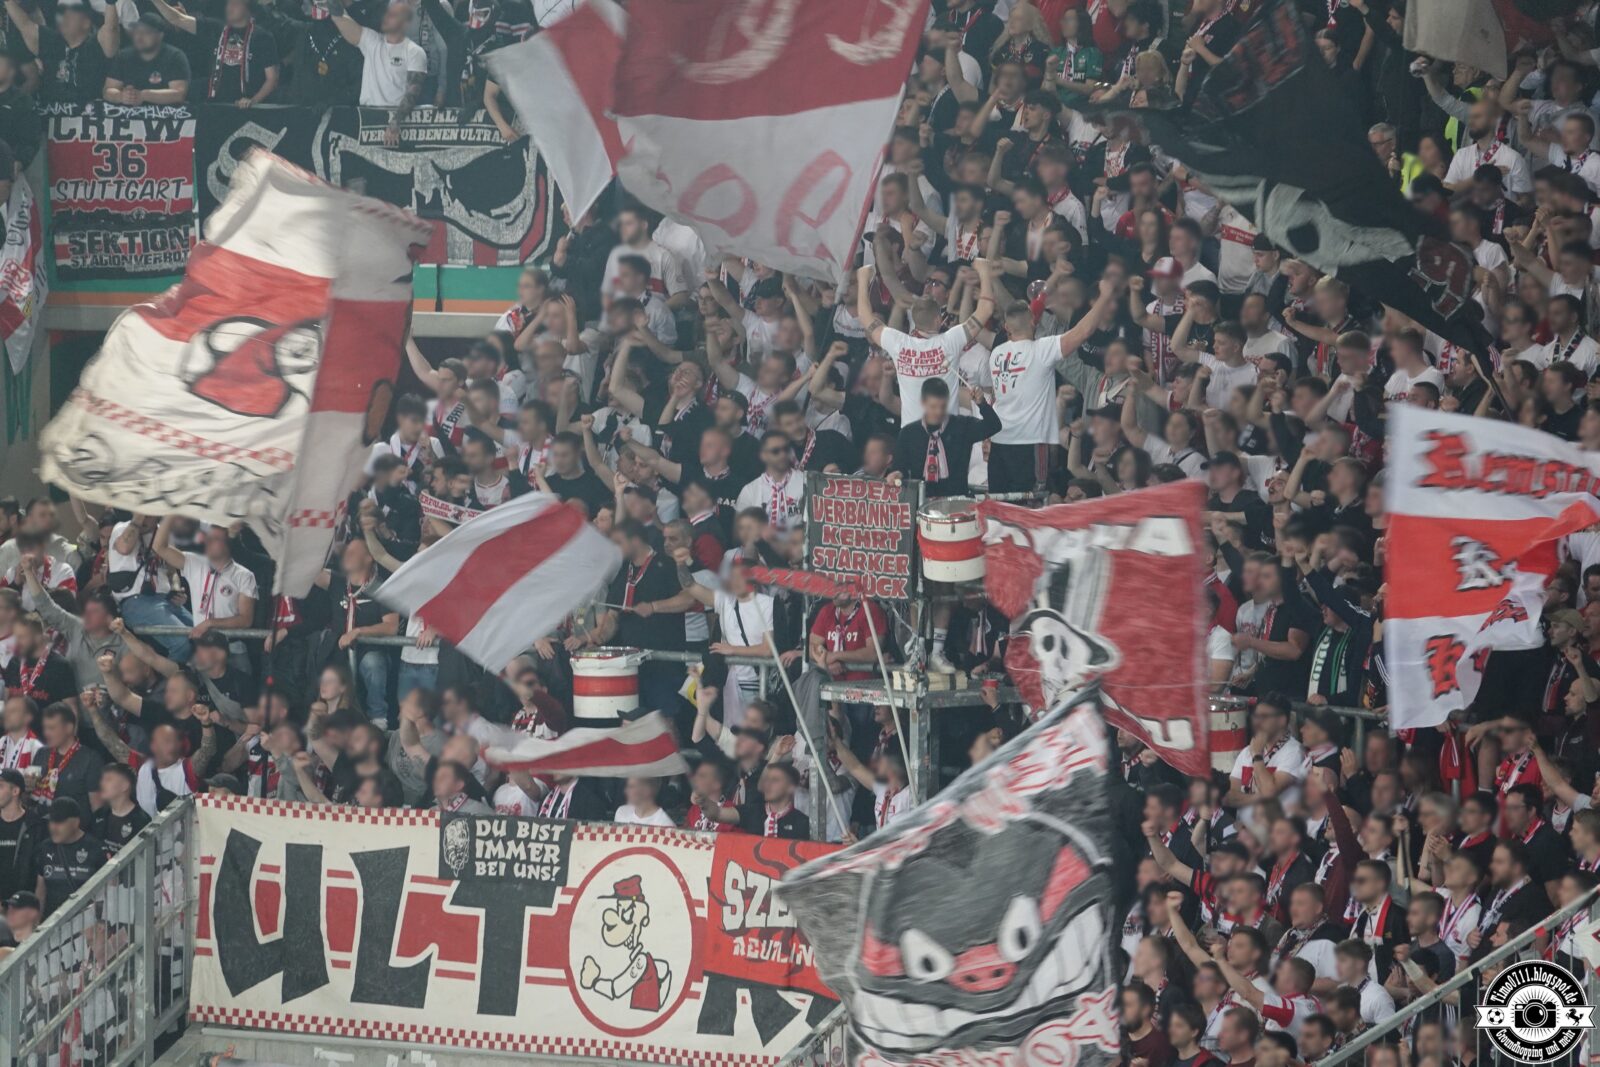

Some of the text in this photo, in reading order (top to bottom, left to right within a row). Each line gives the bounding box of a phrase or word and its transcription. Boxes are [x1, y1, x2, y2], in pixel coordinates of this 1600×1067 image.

[51, 115, 184, 144] CREW
[361, 127, 460, 142] VERORBENEN
[92, 142, 147, 180] 36
[55, 177, 187, 203] STUTTGART
[69, 226, 190, 255] SEKTION
[823, 479, 902, 502] JEDER
[812, 494, 911, 529] VERBANNTE
[822, 525, 902, 551] KEHRT
[475, 820, 566, 842] DU BIST
[475, 839, 561, 865] IMMER
[474, 861, 561, 882] BEI UNS!
[722, 859, 798, 931] SZE
[732, 936, 818, 969] REUTLIN
